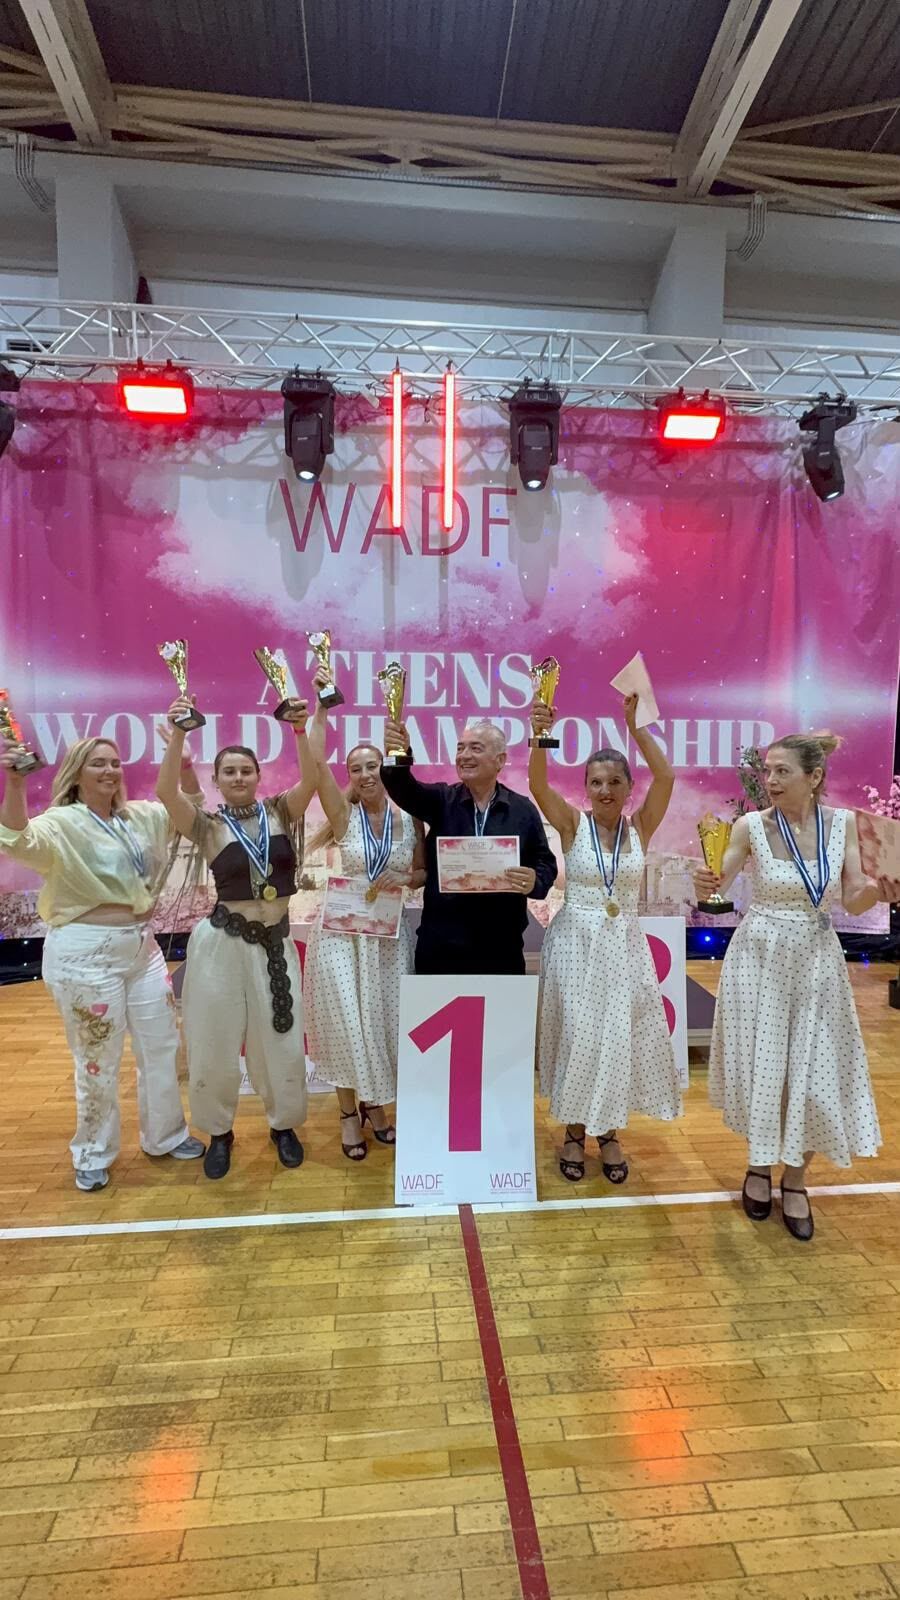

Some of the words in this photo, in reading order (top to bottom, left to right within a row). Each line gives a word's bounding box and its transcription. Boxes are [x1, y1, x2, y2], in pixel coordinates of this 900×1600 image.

[278, 478, 518, 557] WADF
[257, 648, 534, 710] ATHENS
[305, 715, 775, 769] HAMPONSHIP
[407, 996, 486, 1152] 1
[401, 1174, 444, 1190] WADF
[489, 1172, 532, 1189] WADF
